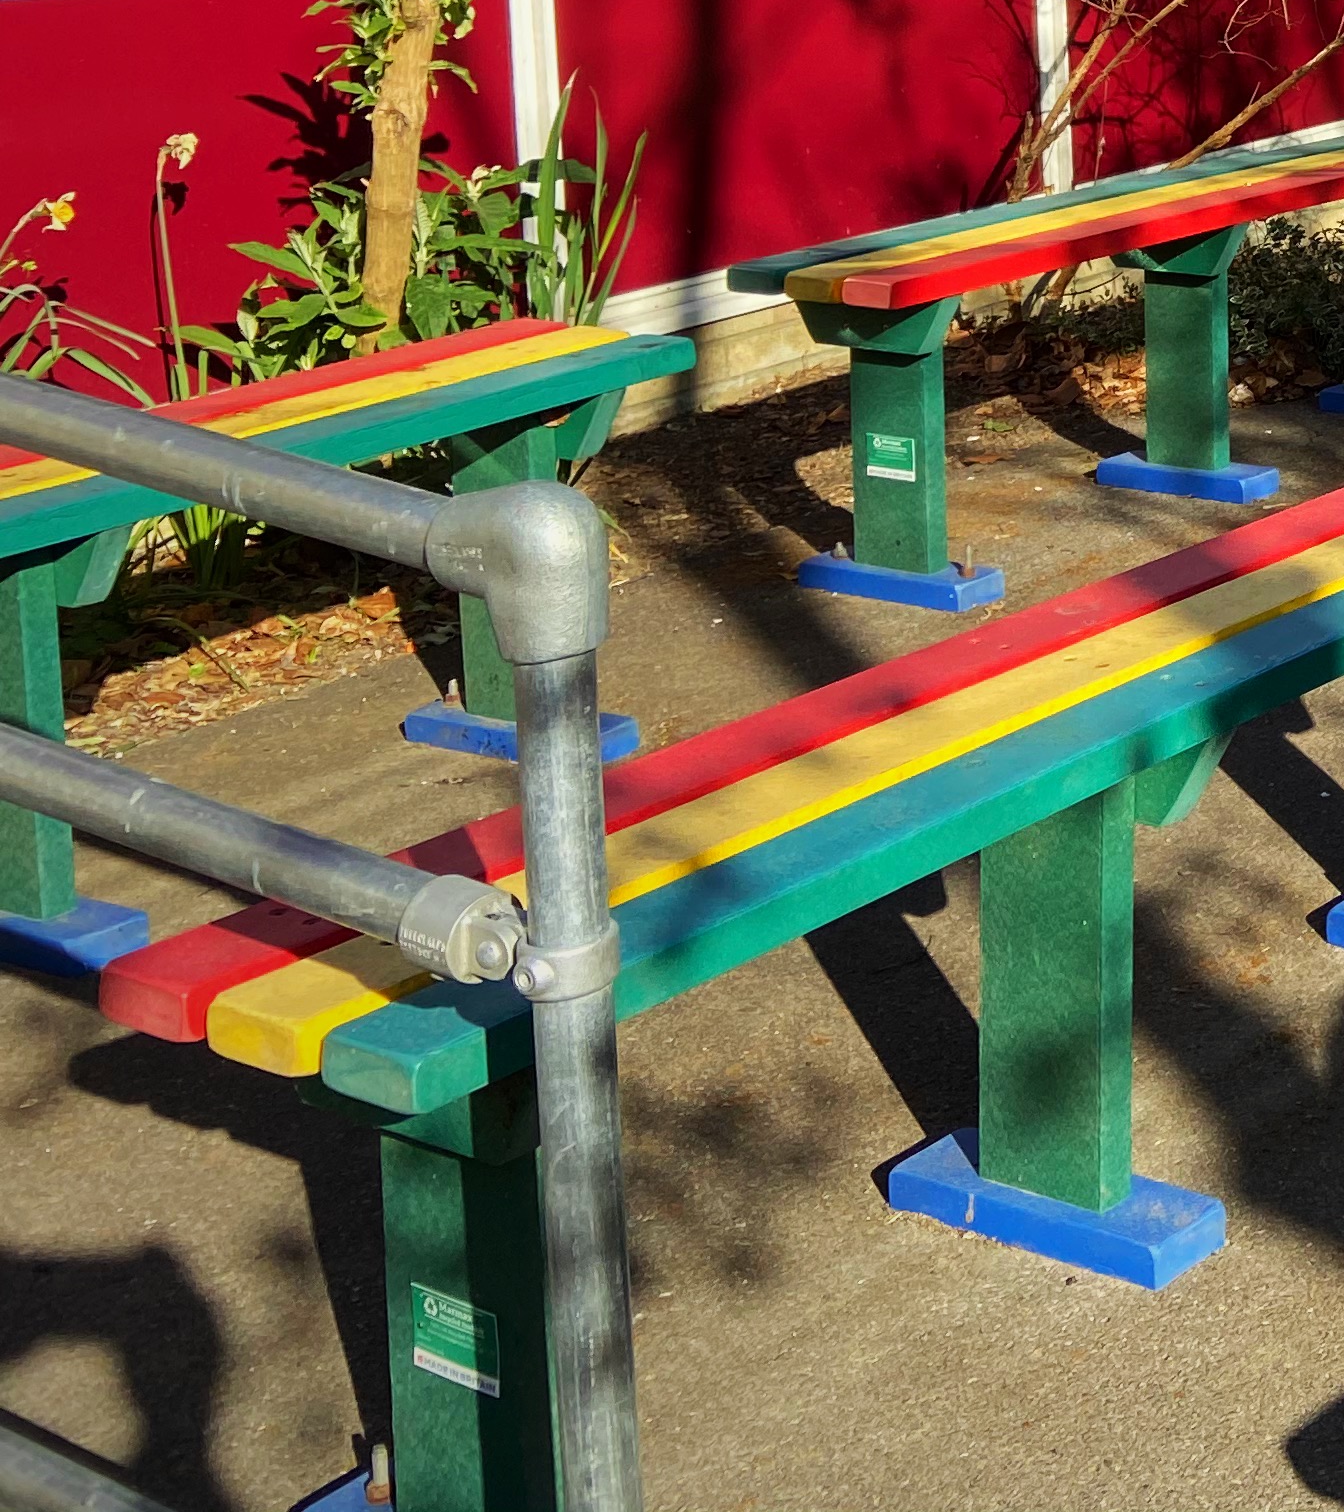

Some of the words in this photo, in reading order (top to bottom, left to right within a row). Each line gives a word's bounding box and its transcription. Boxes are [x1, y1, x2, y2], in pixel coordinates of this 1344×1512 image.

[438, 1301, 473, 1323] Marmax
[423, 1357, 448, 1375] MADE
[449, 1369, 459, 1380] IN
[459, 1372, 496, 1394] BRITAIN
